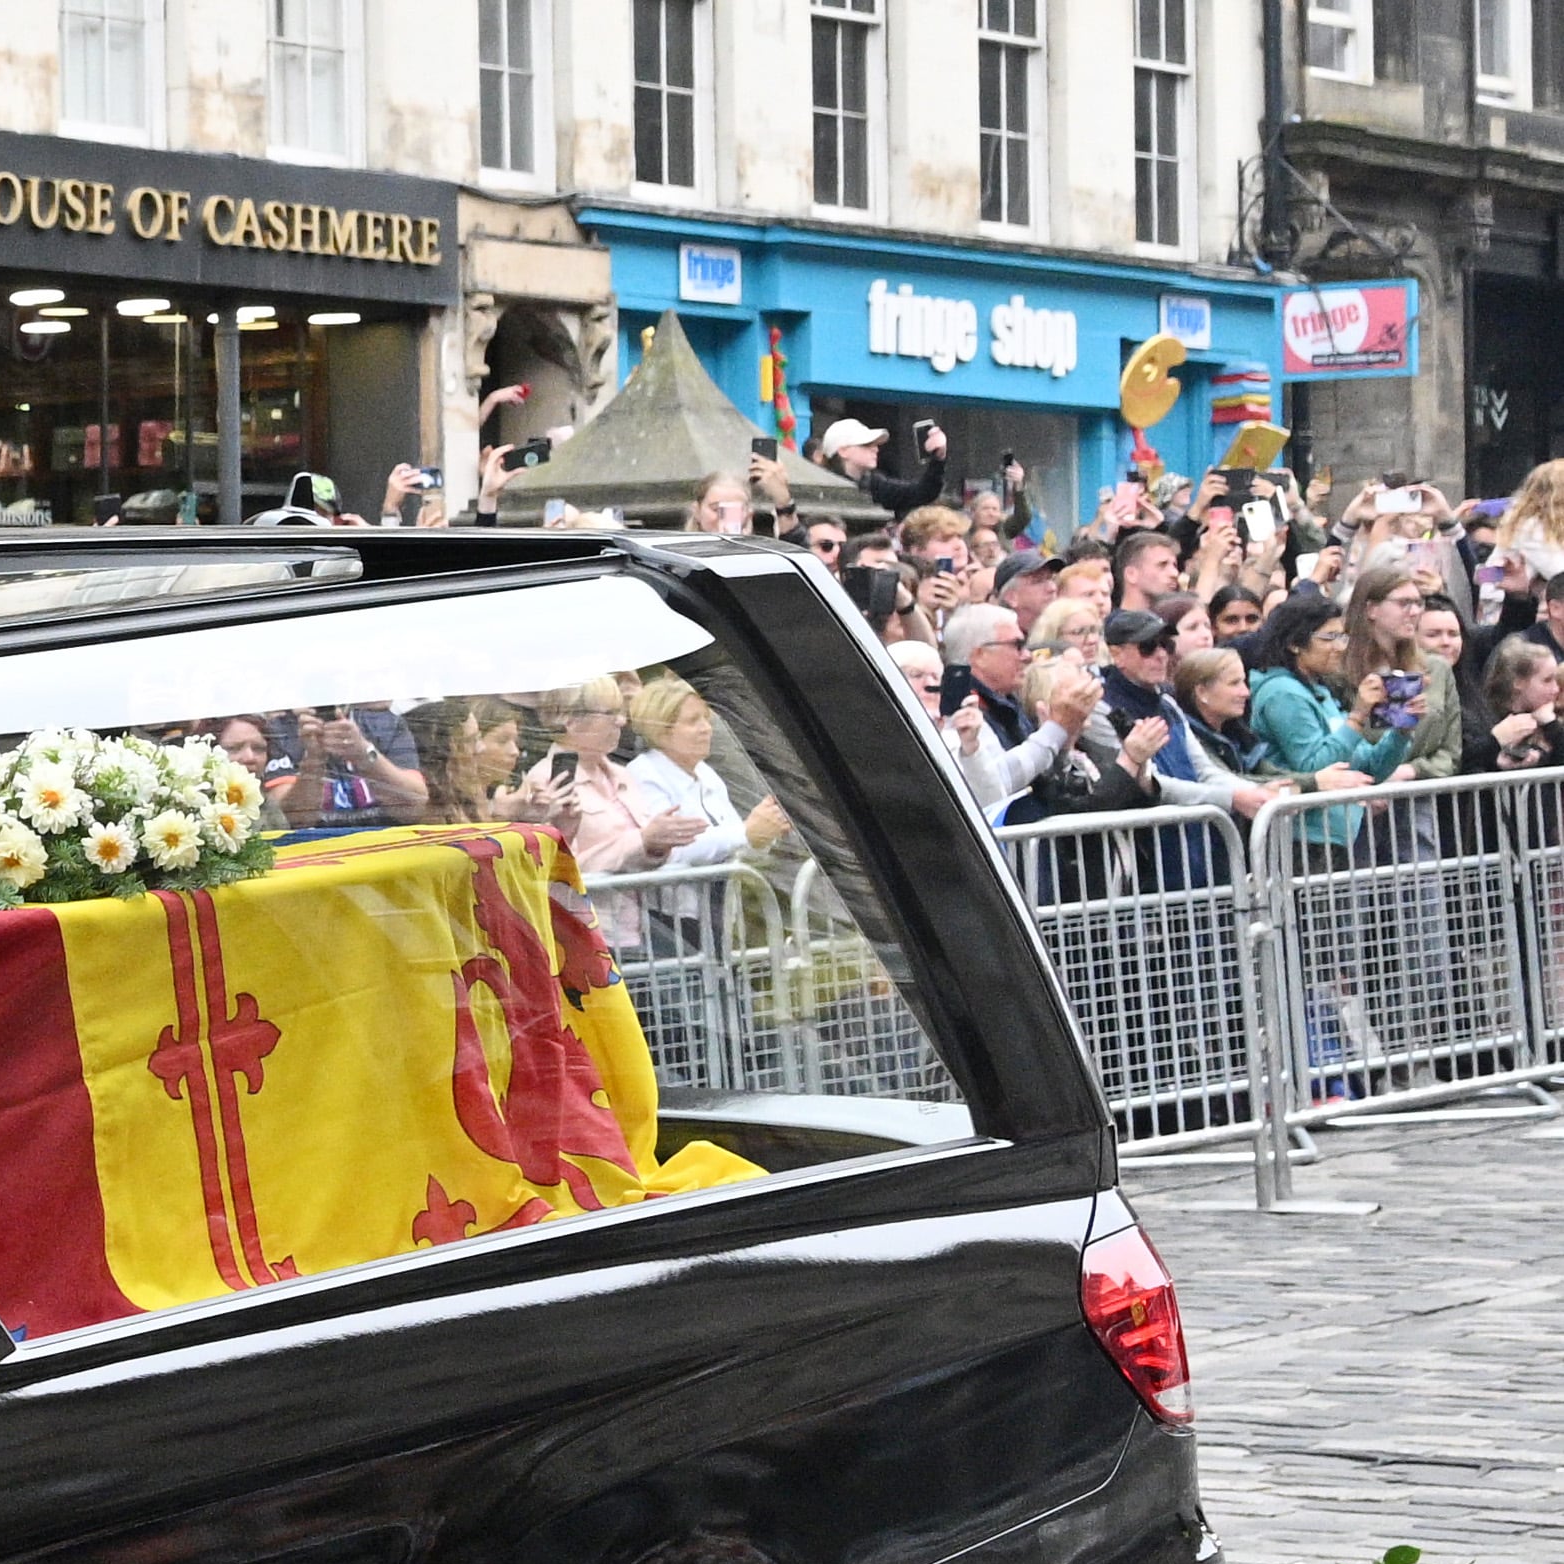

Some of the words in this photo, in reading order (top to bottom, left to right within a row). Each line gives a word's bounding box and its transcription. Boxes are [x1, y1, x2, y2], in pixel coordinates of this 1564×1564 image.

[124, 186, 191, 242] OF
[201, 194, 444, 267] CASHMERE
[686, 248, 736, 289] fringe
[869, 278, 978, 374] fringe
[990, 294, 1078, 378] shop
[1291, 303, 1361, 339] fringe
